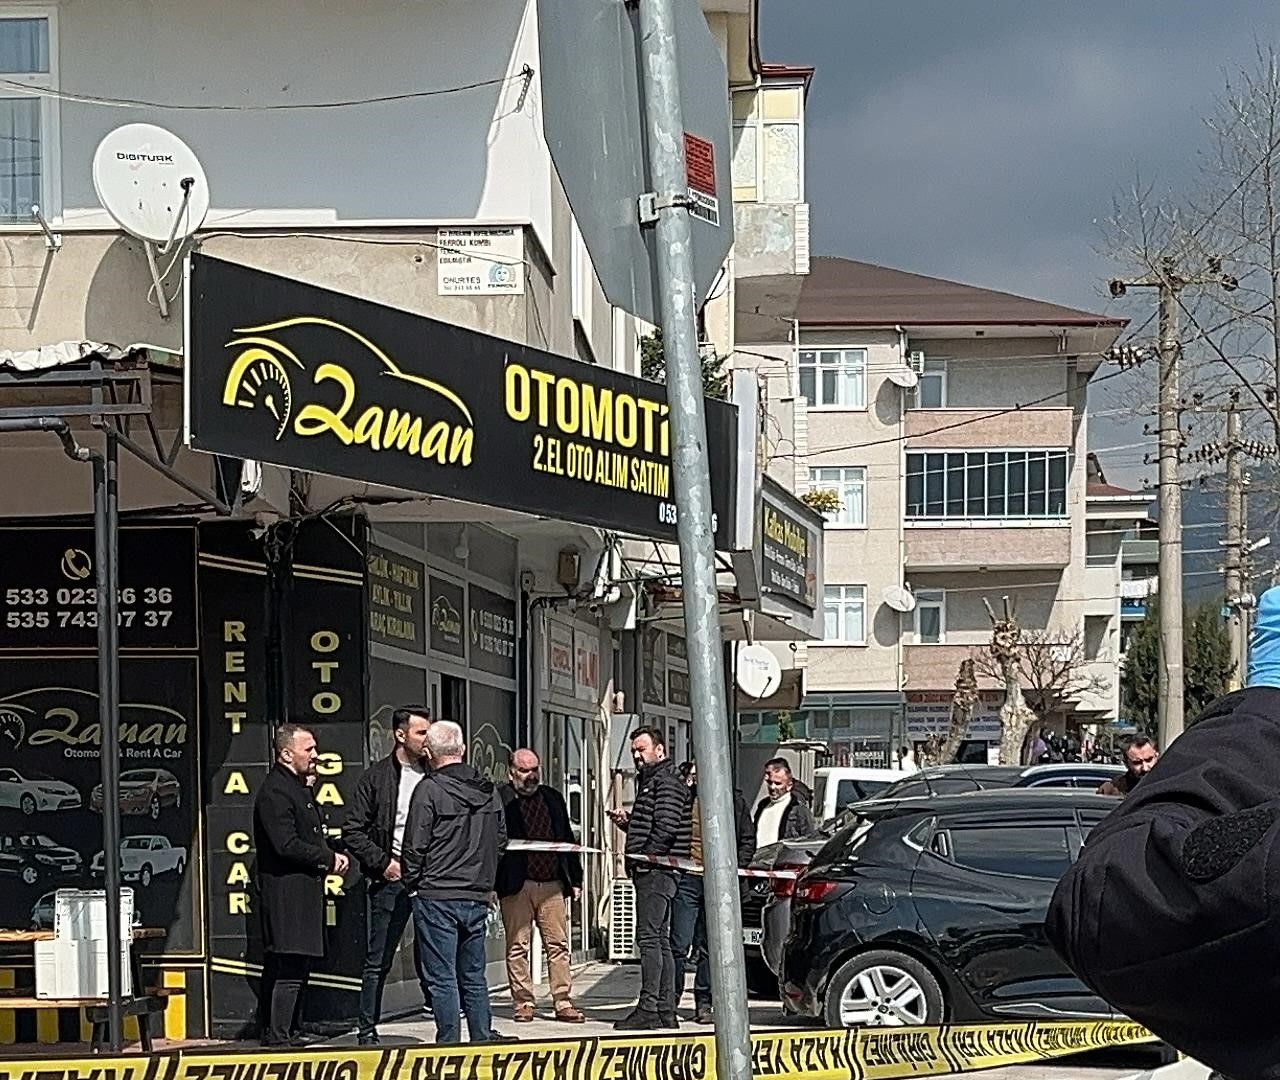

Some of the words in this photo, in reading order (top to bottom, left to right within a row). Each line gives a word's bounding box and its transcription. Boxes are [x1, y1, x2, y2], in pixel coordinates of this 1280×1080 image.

[294, 363, 474, 467] Zaman
[533, 433, 564, 476] 2.EL
[566, 441, 593, 482] OTO
[594, 449, 629, 490] ALIM
[630, 456, 670, 498] SATIM
[5, 588, 49, 605] 533
[56, 588, 99, 605] 023
[143, 587, 173, 604] 36
[6, 611, 50, 628] 535
[56, 611, 99, 628] 743
[117, 611, 137, 627] 7
[144, 610, 173, 627] 37
[223, 620, 247, 734] RENT
[310, 630, 342, 714] OTO
[126, 748, 150, 758] Rent
[152, 748, 162, 758] A
[163, 748, 183, 759] Car
[224, 771, 250, 794] A
[226, 832, 253, 915] CAR
[790, 1036, 846, 1073] KAZA
[860, 1032, 938, 1071] GİRİLMEZ
[987, 1028, 1028, 1056] KAZA
